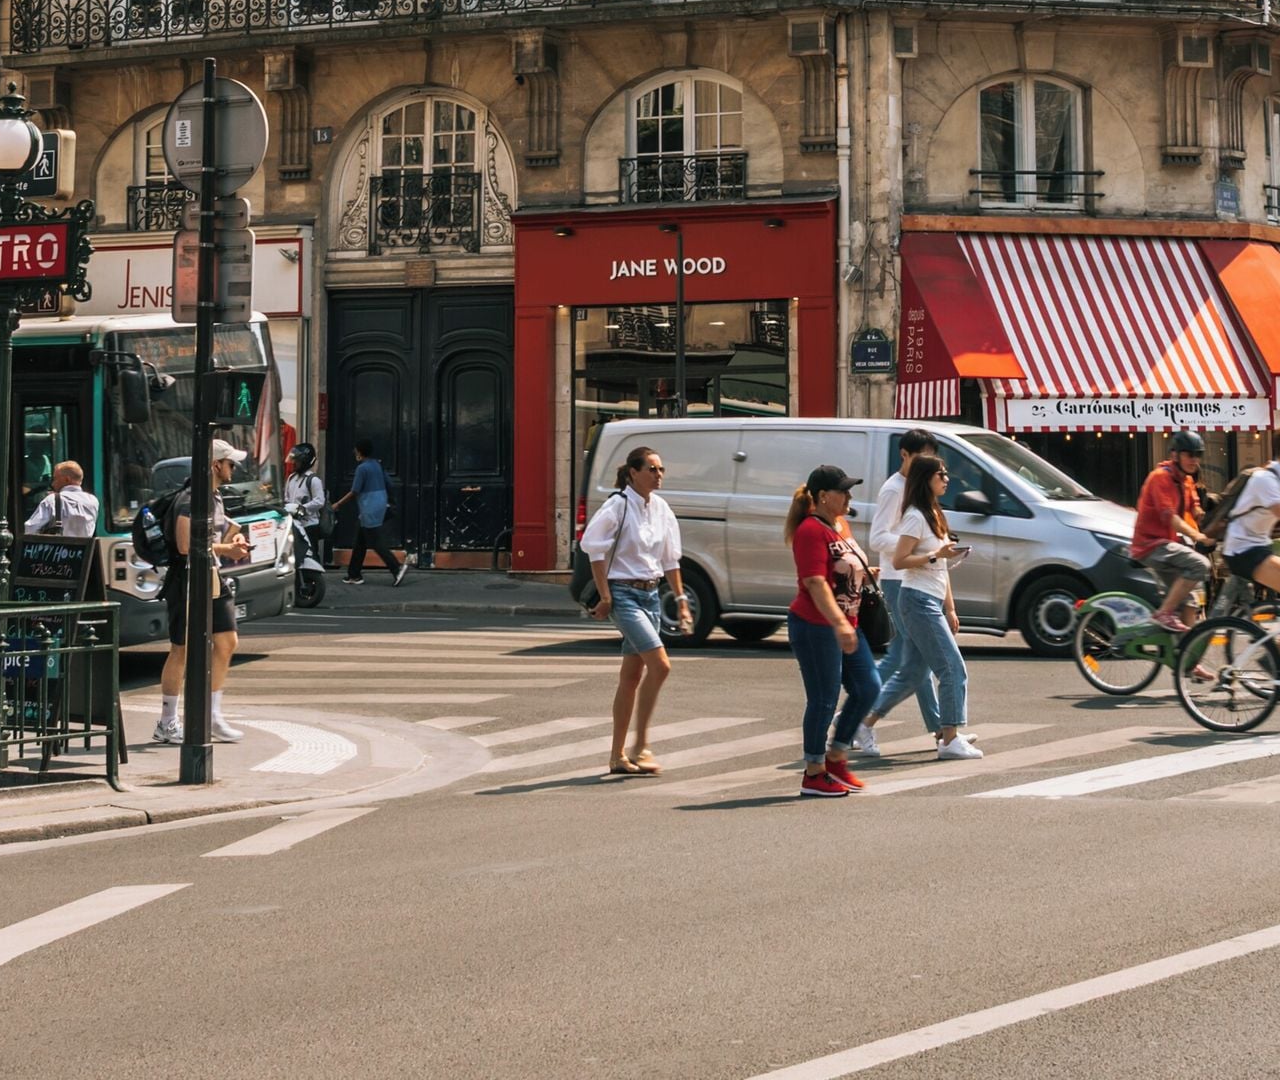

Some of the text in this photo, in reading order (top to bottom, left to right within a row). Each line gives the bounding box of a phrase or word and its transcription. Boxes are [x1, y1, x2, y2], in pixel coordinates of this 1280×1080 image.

[609, 256, 726, 280] JANE WOOD
[905, 326, 914, 374] PARIS
[915, 327, 924, 374] 1920
[1056, 399, 1221, 426] Carrousel de Rennes
[24, 543, 82, 562] HAPPY HOUR
